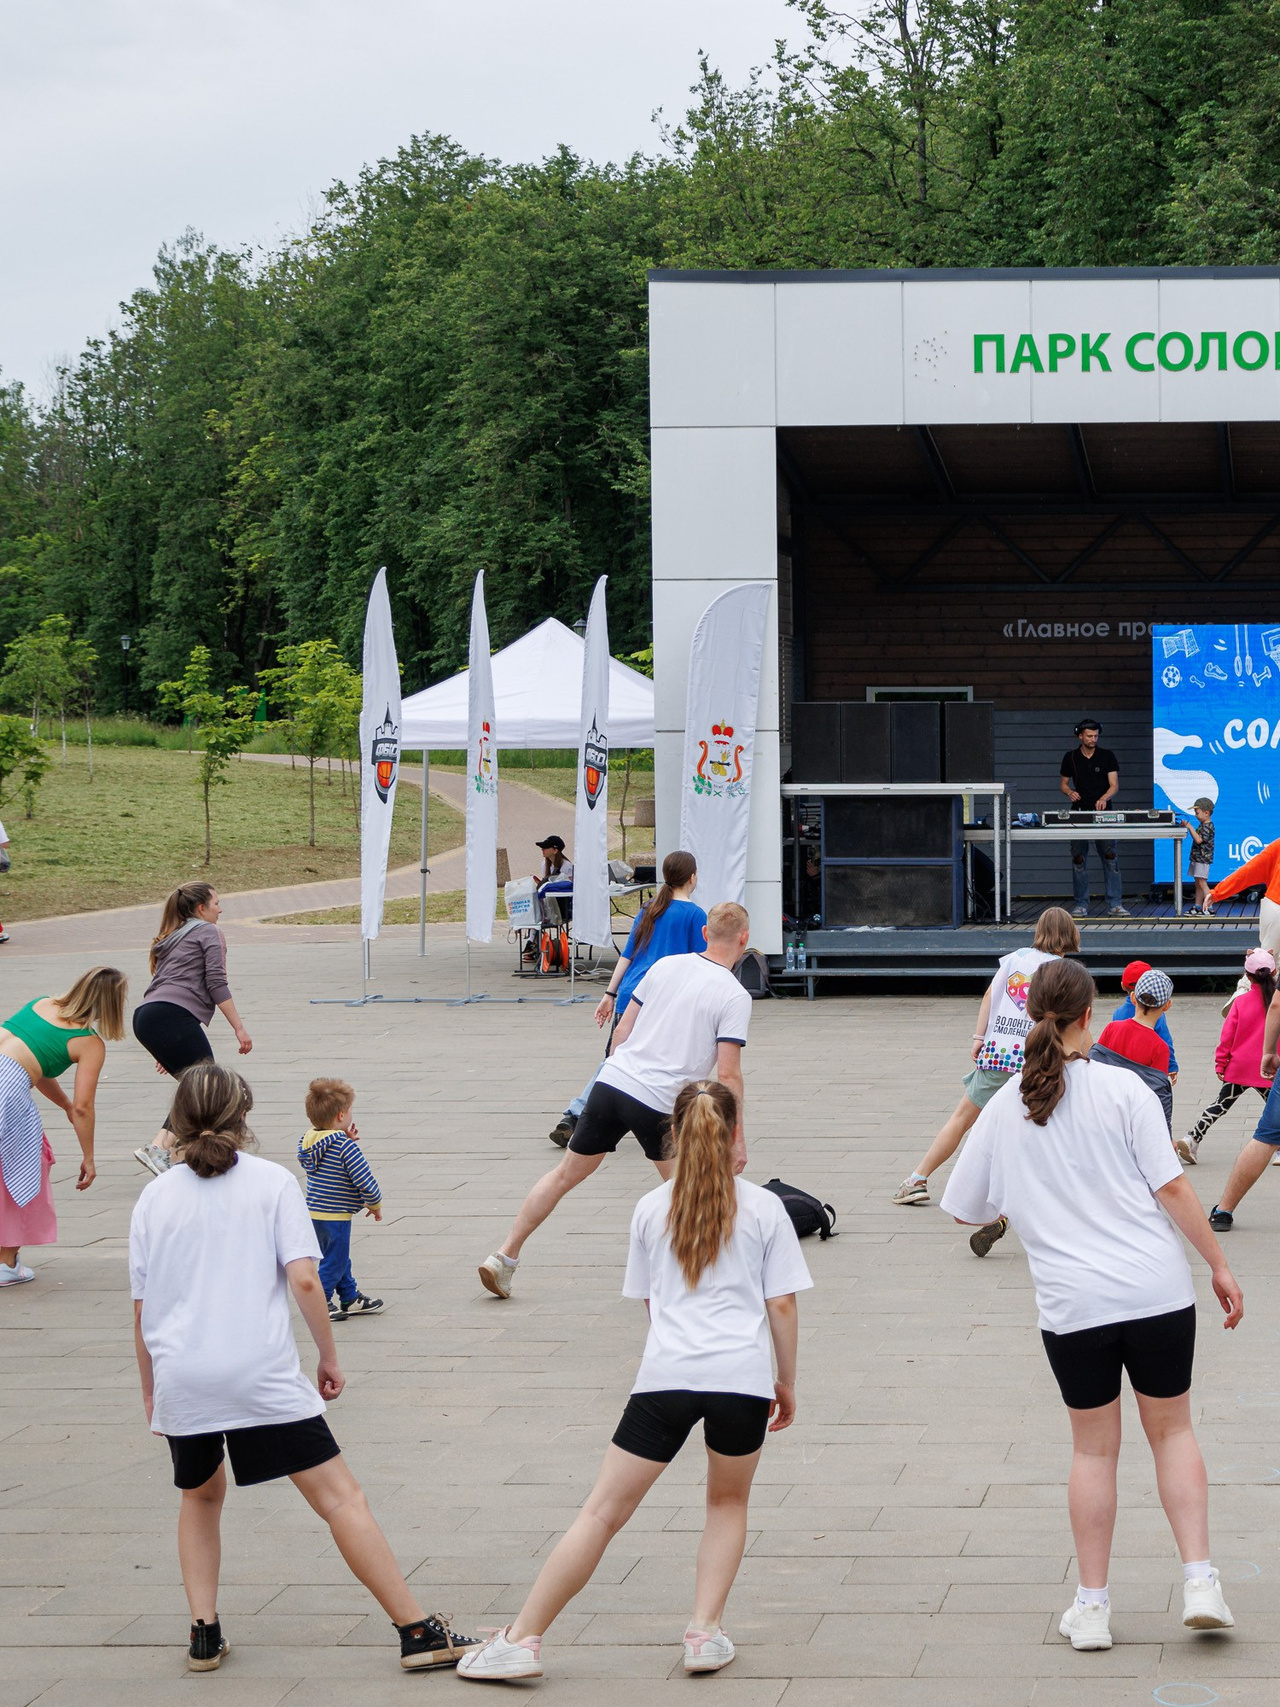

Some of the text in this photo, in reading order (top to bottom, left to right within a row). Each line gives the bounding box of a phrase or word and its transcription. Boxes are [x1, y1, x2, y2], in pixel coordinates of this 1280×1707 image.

[973, 332, 1111, 373] ПАРК
[1003, 618, 1111, 638] «Главное
[995, 1015, 1033, 1028] ВОЛОНТЕ
[993, 1025, 1029, 1038] СМОЛЕНЩ
